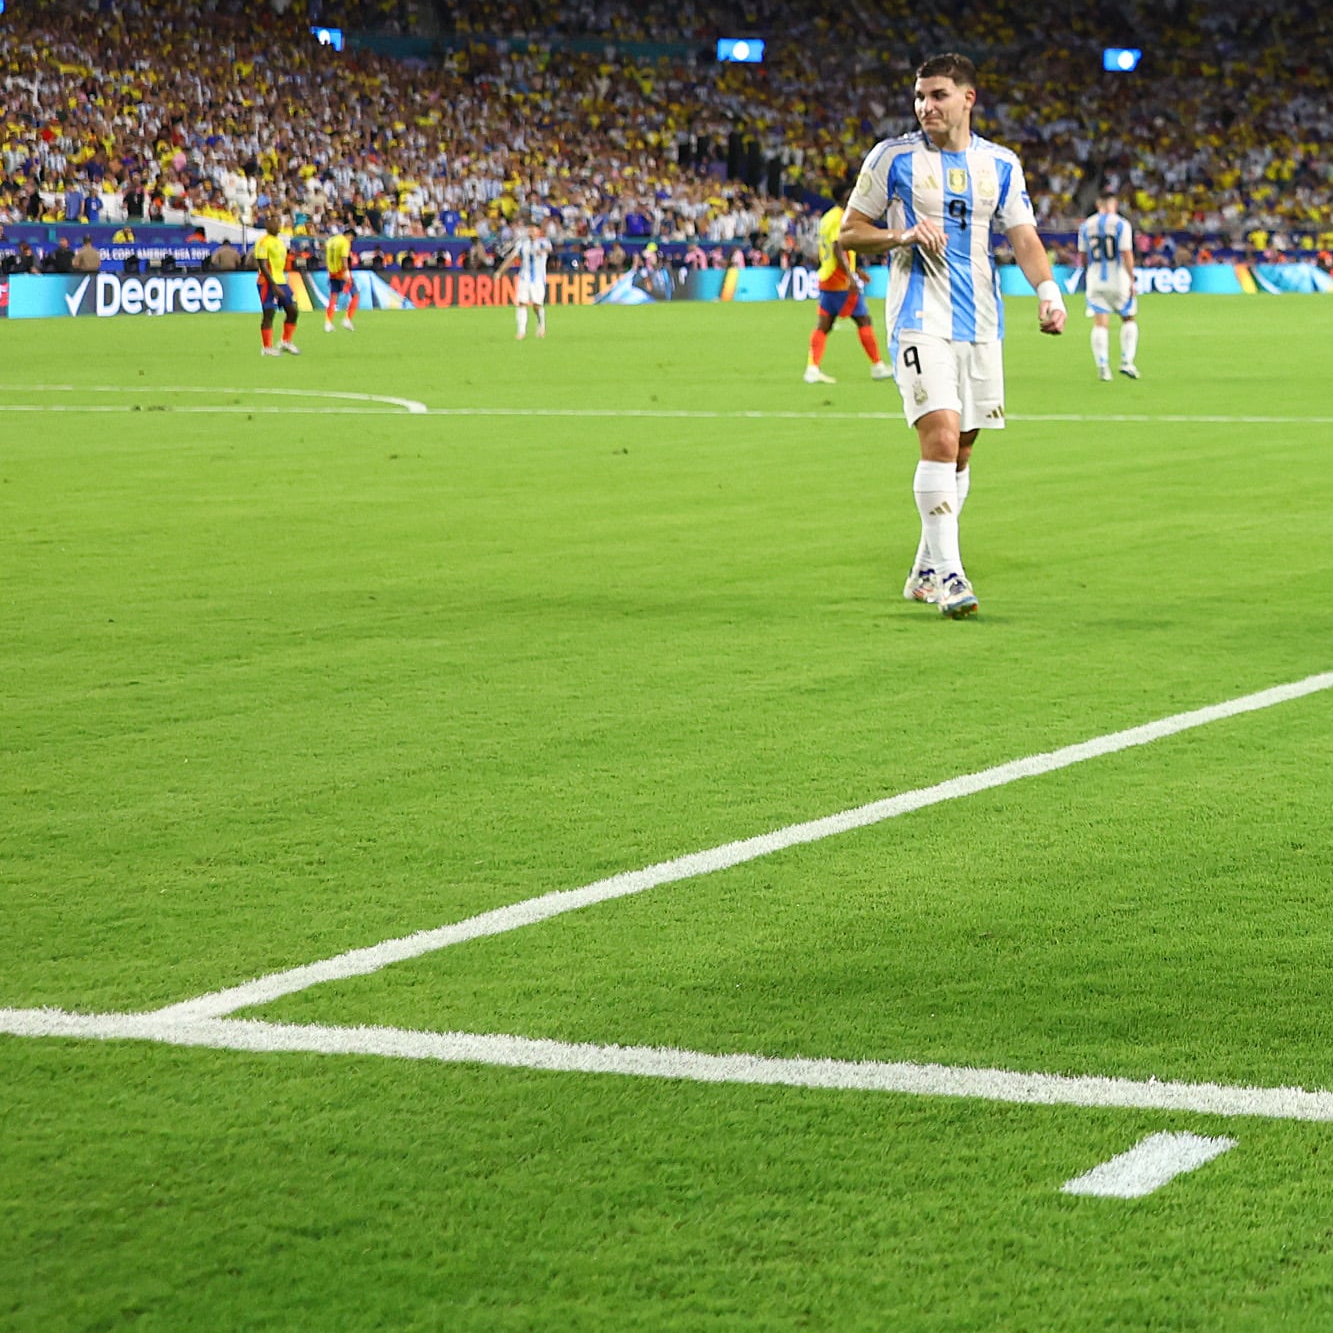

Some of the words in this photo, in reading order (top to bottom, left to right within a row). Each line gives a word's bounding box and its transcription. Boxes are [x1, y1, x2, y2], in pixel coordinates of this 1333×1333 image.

[950, 199, 967, 231] 9
[1090, 235, 1117, 262] 20
[96, 274, 223, 316] Degree
[390, 274, 451, 309] YOU
[459, 274, 518, 308] BRIN
[546, 274, 596, 306] THE
[904, 345, 922, 375] 9
